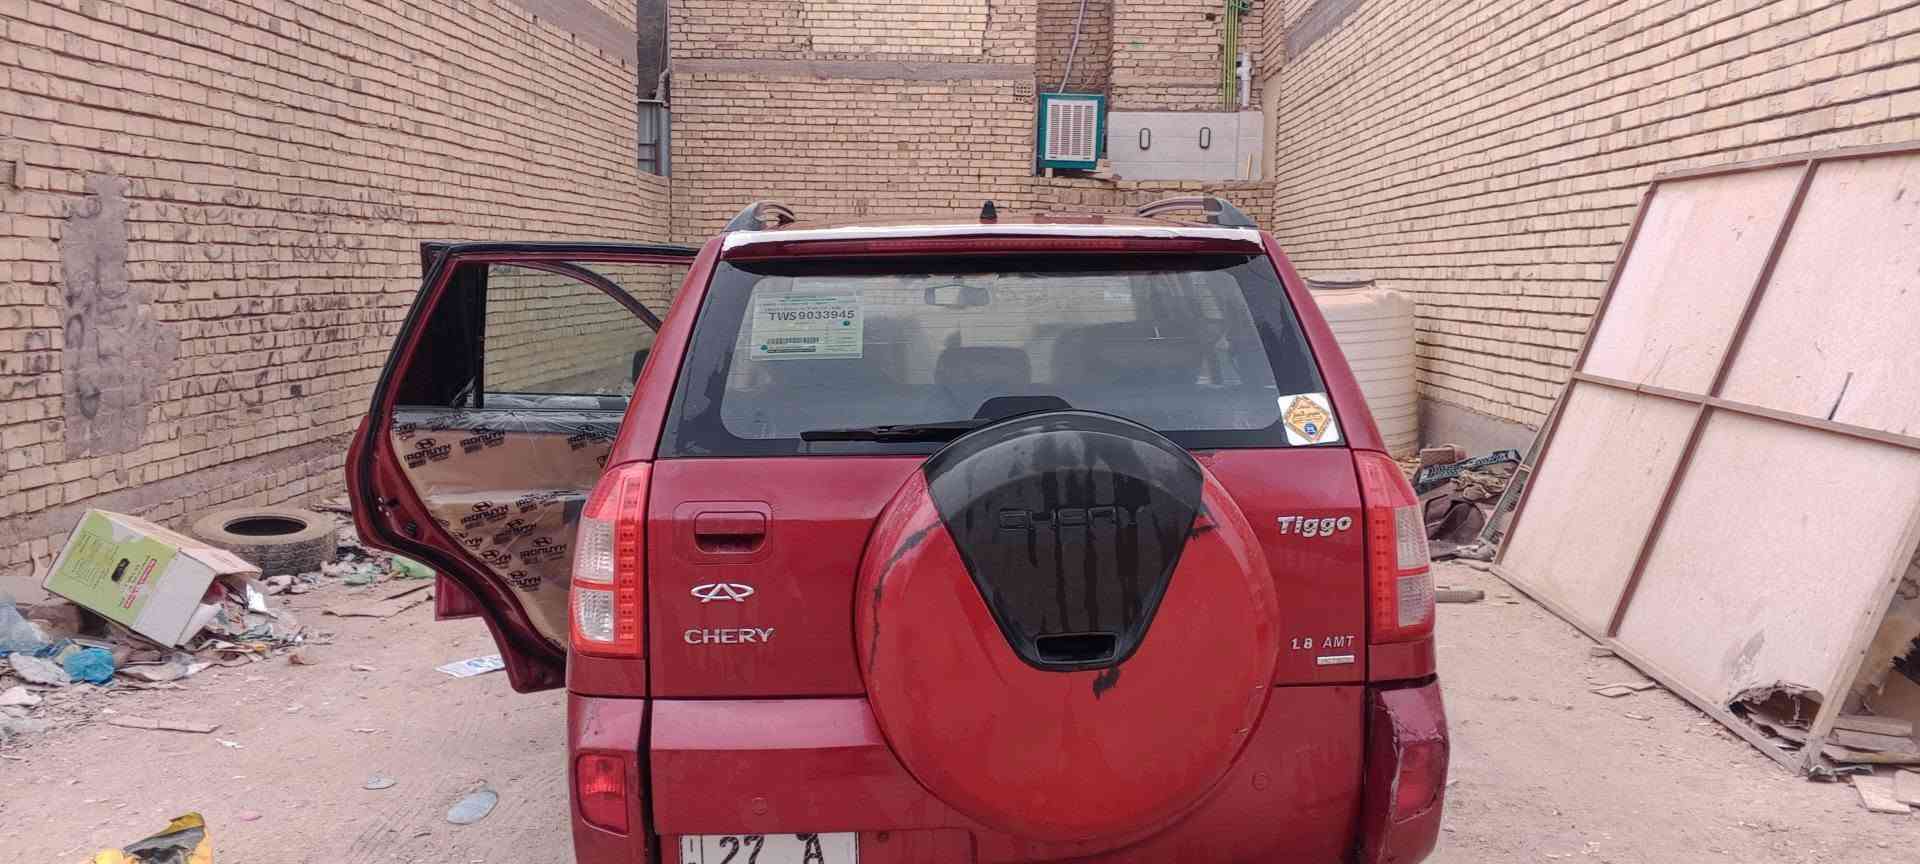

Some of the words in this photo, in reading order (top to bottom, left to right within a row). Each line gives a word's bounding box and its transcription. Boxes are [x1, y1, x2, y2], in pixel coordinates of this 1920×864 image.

[769, 310, 856, 321] TWS9033945
[1277, 515, 1353, 538] Tiggo
[684, 627, 775, 645] CHERY
[1322, 635, 1355, 649] AMT
